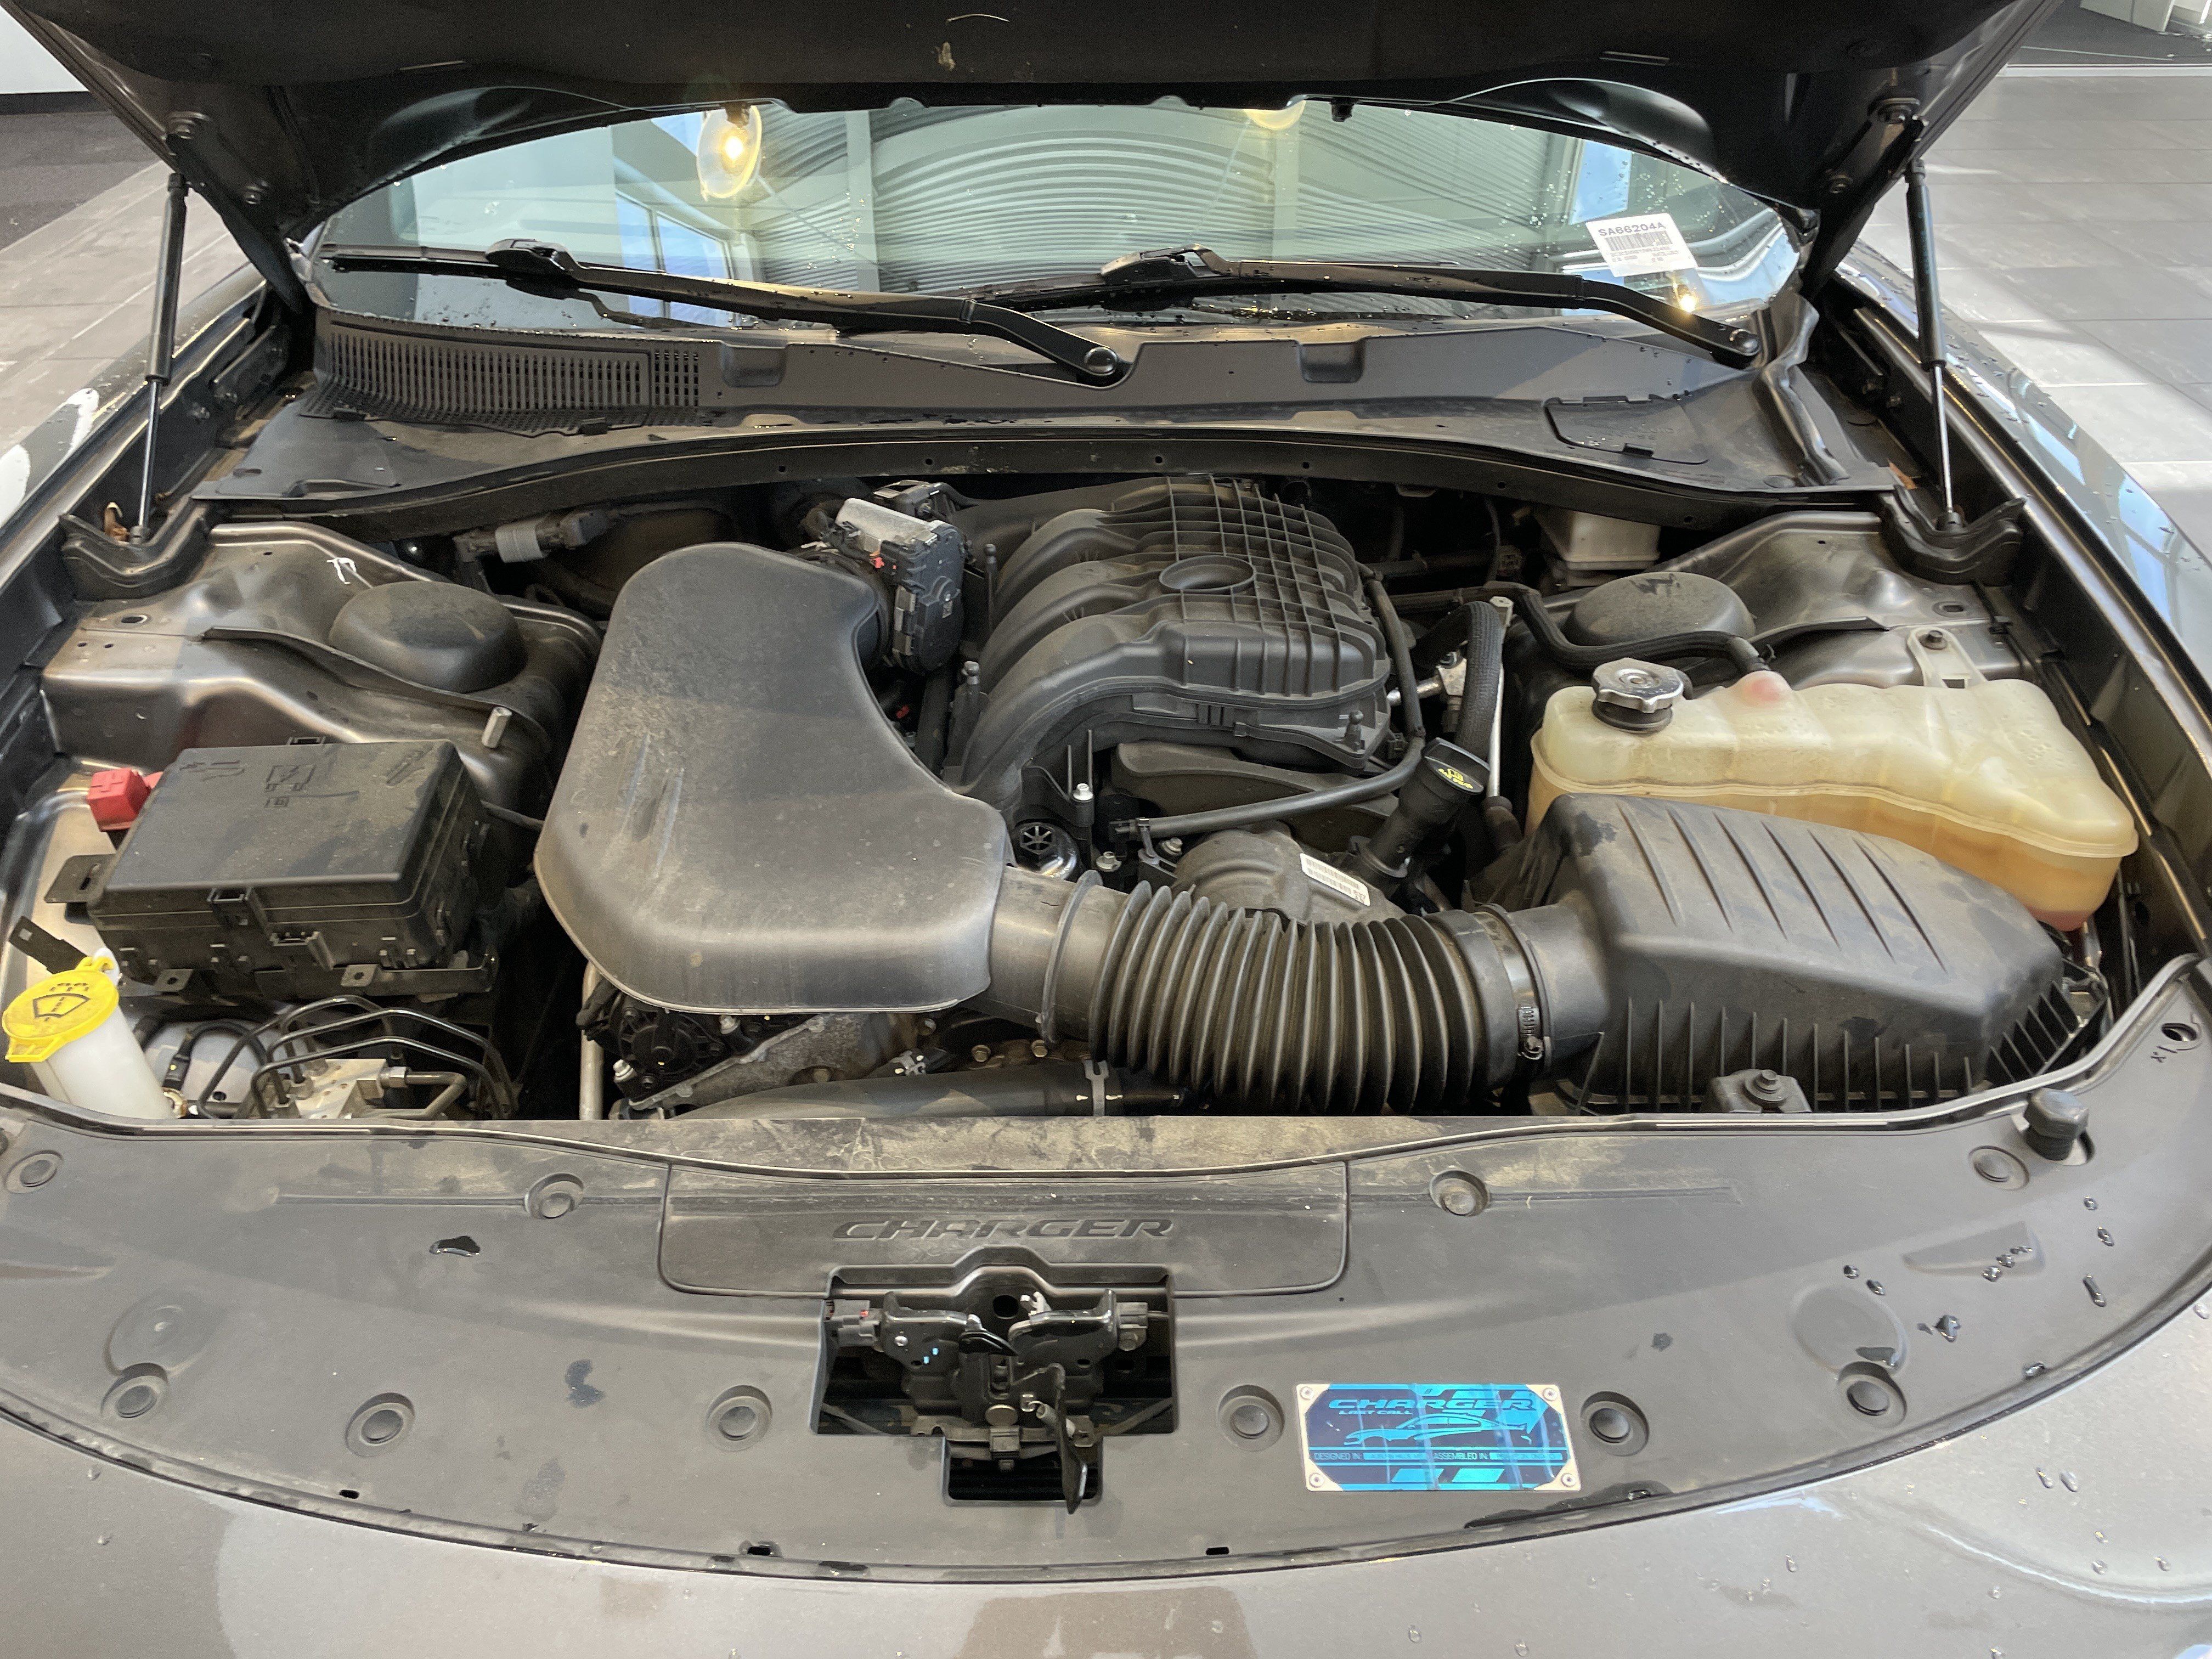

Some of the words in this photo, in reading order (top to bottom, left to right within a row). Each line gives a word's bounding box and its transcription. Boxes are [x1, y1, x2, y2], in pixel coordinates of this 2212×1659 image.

[1598, 222, 1667, 236] SA66204A
[833, 1218, 1173, 1240] CHARGER
[1328, 1399, 1538, 1410] CHARGER
